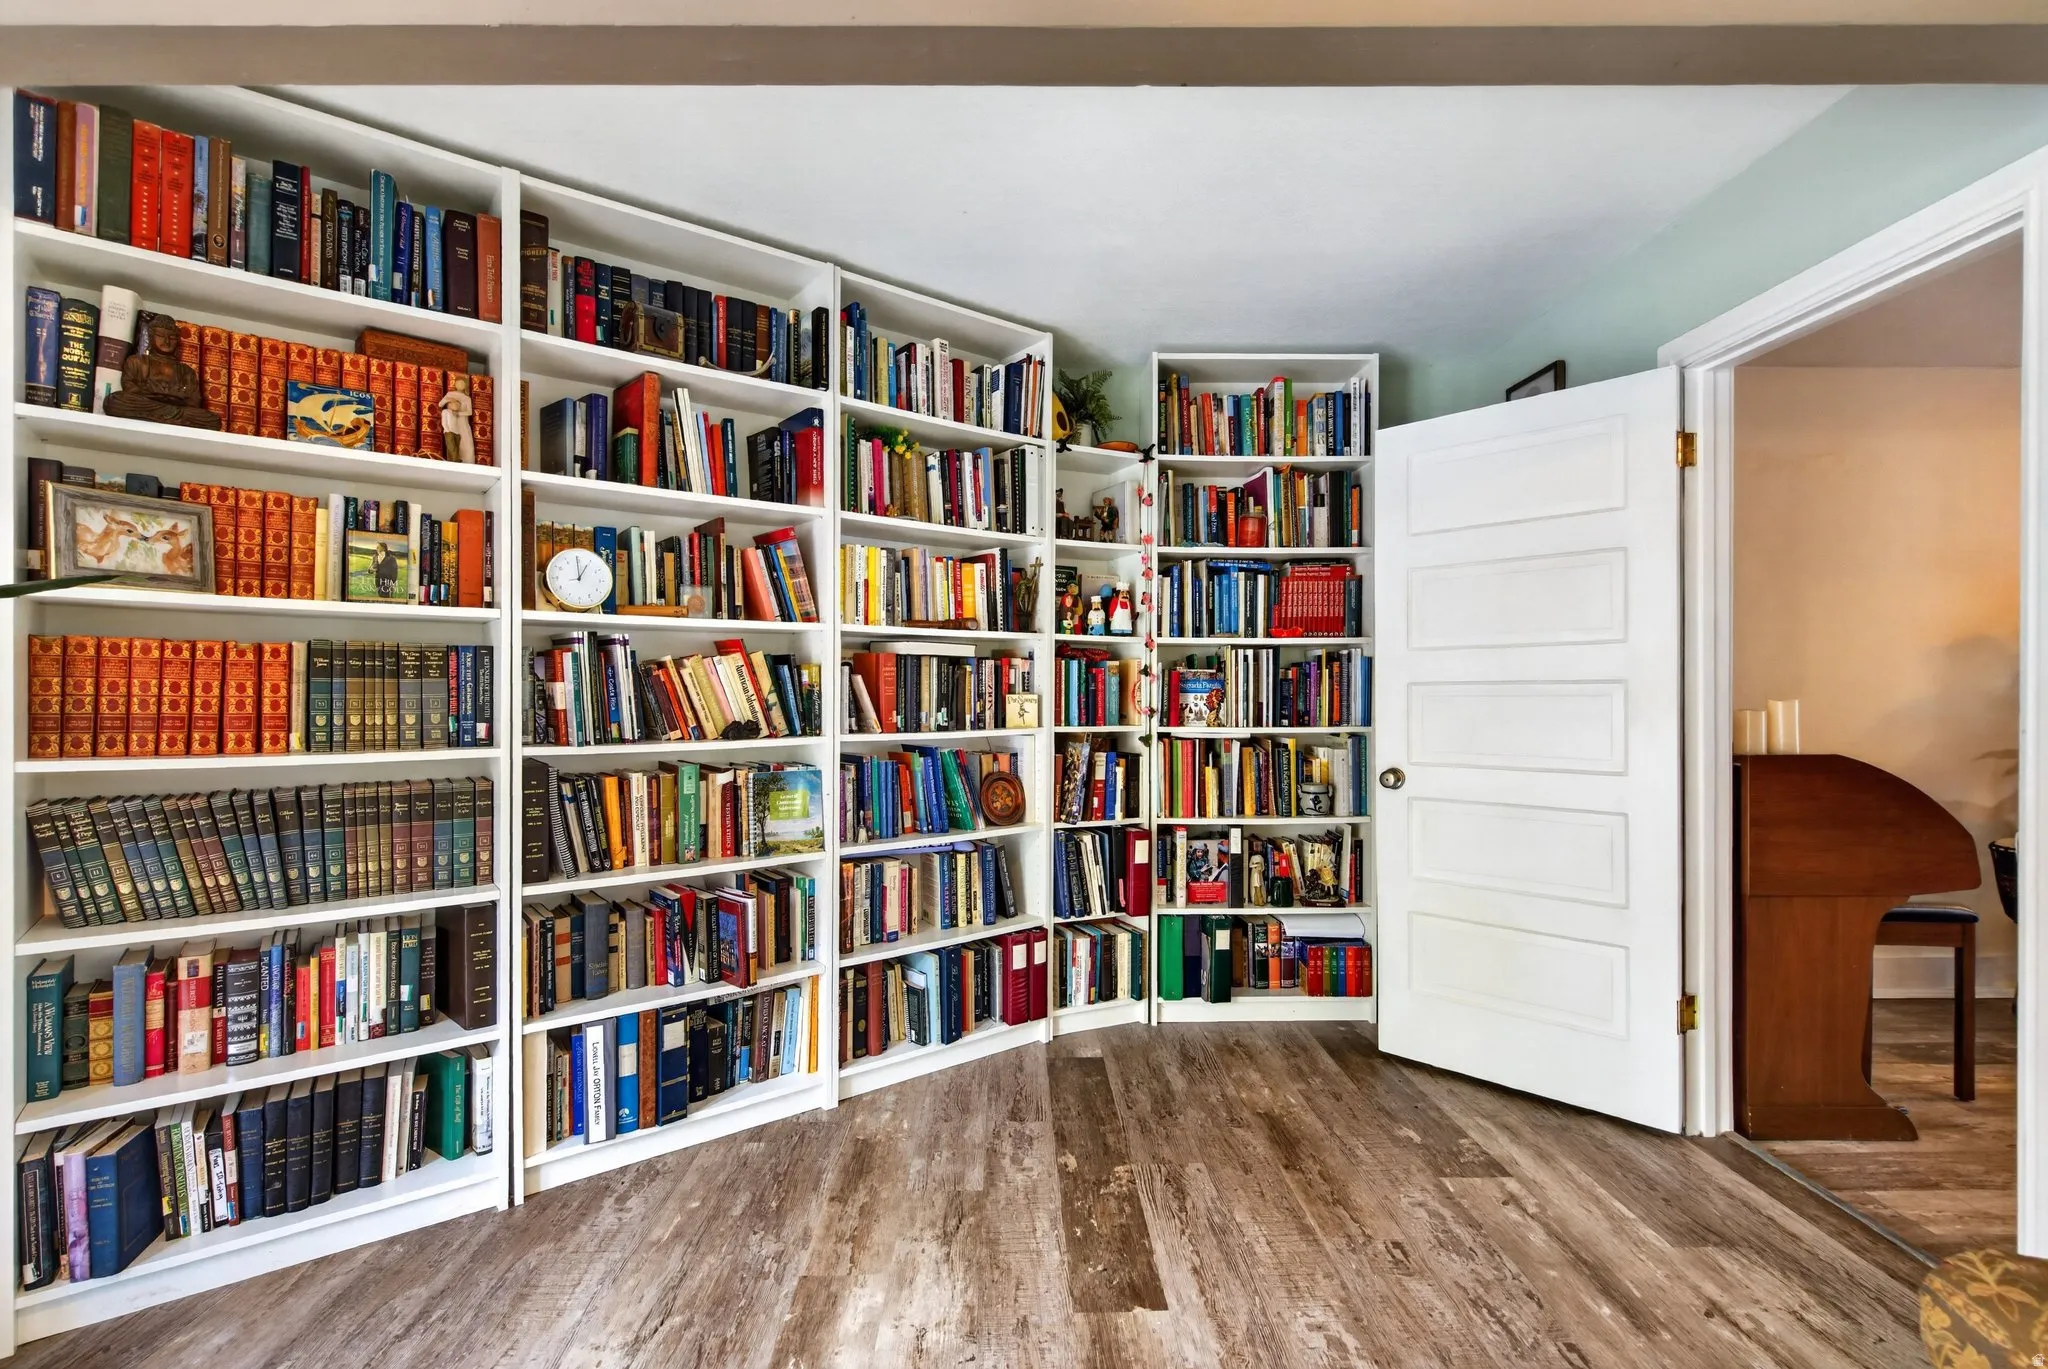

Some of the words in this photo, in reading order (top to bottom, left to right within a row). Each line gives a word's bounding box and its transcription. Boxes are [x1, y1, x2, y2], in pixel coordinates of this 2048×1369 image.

[63, 348, 90, 357] NOBLE
[68, 341, 84, 350] THE
[379, 578, 397, 587] HIM
[381, 585, 405, 593] GOD
[736, 664, 751, 694] American
[260, 957, 268, 990] PLANTED
[45, 1038, 55, 1054] VIEW
[454, 1084, 462, 1095] The
[593, 1078, 601, 1104] ORTON
[594, 1106, 602, 1126] FAMILY
[171, 1127, 184, 1162] FORGIVING
[174, 1163, 186, 1198] OURSELVES
